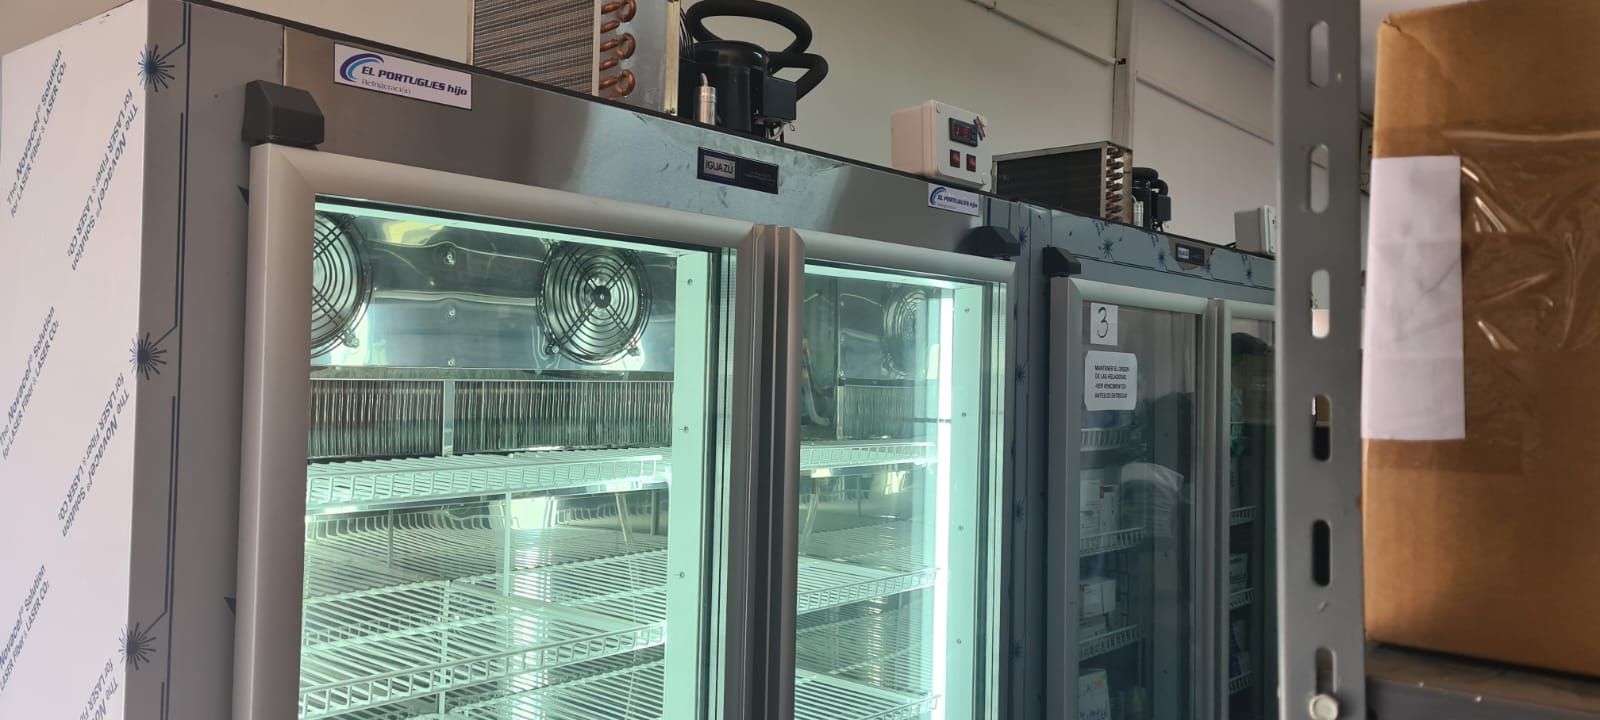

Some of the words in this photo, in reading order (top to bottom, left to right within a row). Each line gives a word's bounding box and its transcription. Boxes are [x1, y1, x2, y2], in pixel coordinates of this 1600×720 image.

[123, 88, 133, 110] for
[361, 66, 375, 76] EL
[378, 69, 446, 91] PORTUGUES
[447, 84, 468, 96] hijo
[7, 182, 18, 205] The
[41, 49, 62, 106] Solution
[107, 109, 125, 152] LASER
[125, 103, 138, 131] The
[10, 200, 19, 218] for
[17, 163, 32, 200] LASER
[30, 134, 42, 164] Fiber
[44, 87, 59, 125] LASER
[96, 152, 109, 186] Fiber
[705, 160, 734, 174] IGUAZÚ
[76, 195, 94, 235] LASER
[71, 215, 96, 271] Solution
[33, 306, 55, 358] Solution
[1097, 306, 1109, 338] 3
[2, 443, 11, 460] for
[8, 410, 23, 445] LASER
[21, 382, 34, 412] Fiber
[35, 340, 51, 377] LASER
[115, 372, 124, 393] for
[116, 389, 130, 414] The
[98, 391, 117, 431] LASER
[86, 427, 100, 460] Fiber
[66, 464, 84, 503] LASER
[62, 486, 86, 537] Solution
[24, 564, 46, 611] Solution
[12, 634, 24, 663] Fiber
[26, 598, 41, 632] LASER
[104, 658, 113, 678] for
[87, 674, 105, 711] LASER
[105, 676, 118, 700] The
